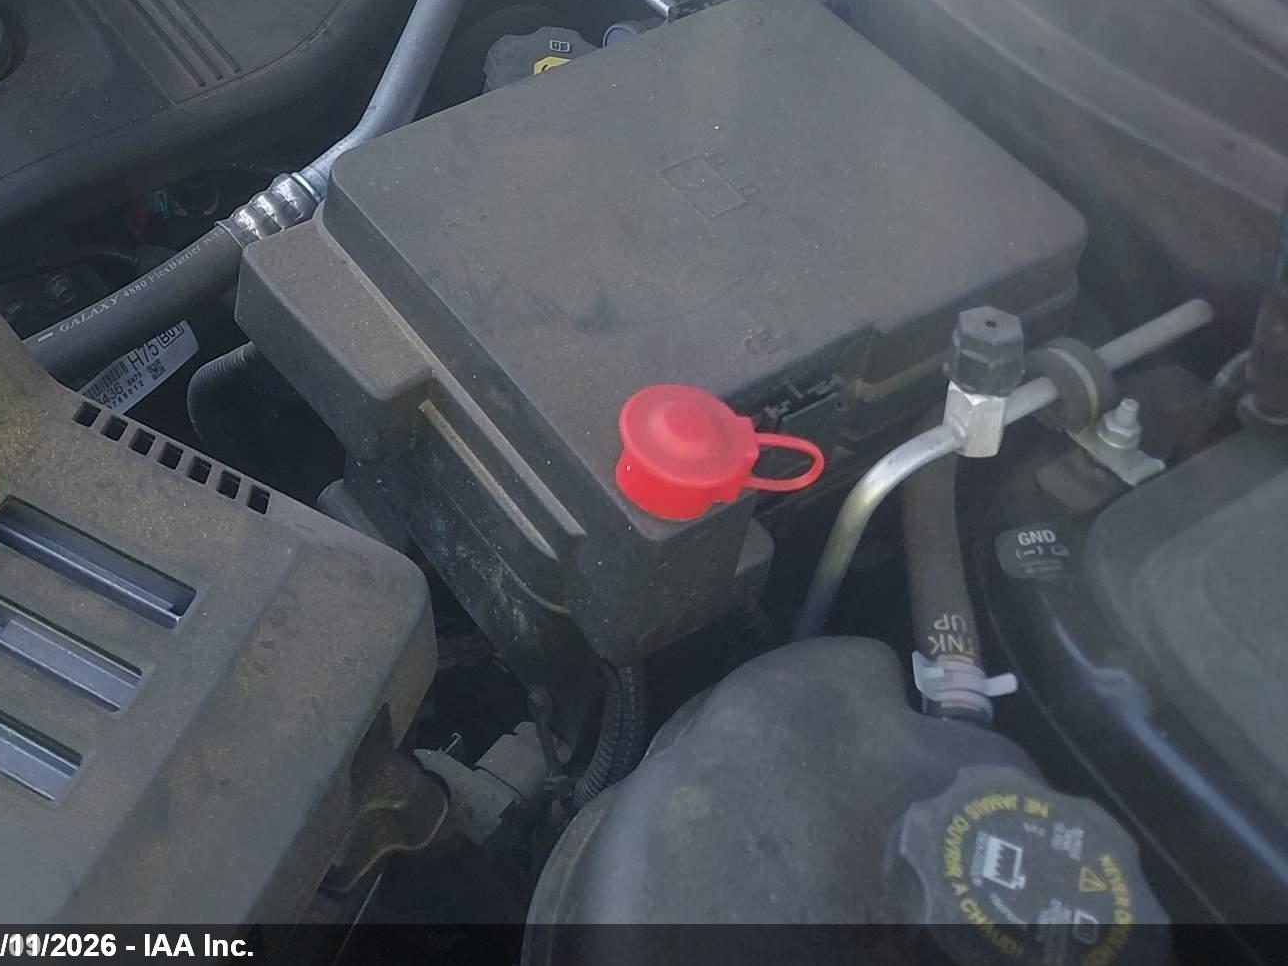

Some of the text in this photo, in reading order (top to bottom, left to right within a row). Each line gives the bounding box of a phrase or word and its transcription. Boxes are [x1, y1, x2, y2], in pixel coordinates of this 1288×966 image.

[58, 295, 121, 332] GALAXY
[1017, 529, 1056, 547] GND
[934, 613, 966, 633] UP
[943, 814, 970, 877] OUVRIR
